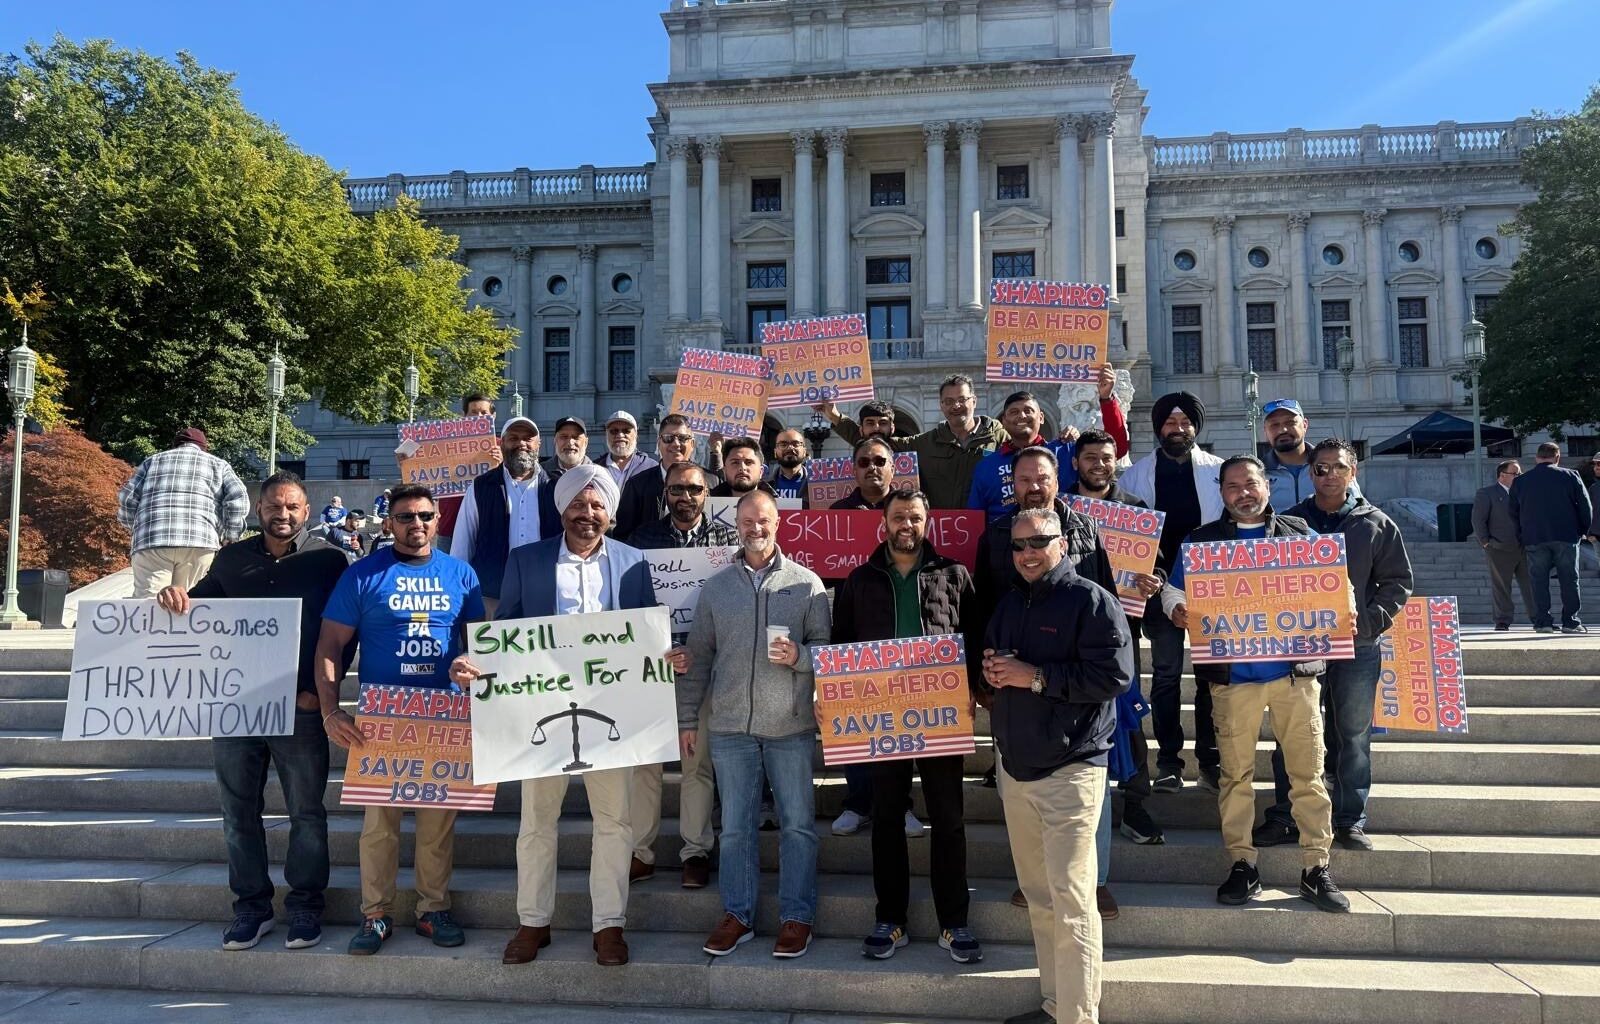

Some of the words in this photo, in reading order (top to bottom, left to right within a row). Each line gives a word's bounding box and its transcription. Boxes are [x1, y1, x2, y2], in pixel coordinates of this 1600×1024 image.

[994, 282, 1106, 307] SHAPIRO
[763, 317, 862, 343] SHAPIRO
[993, 310, 1019, 328] BE
[1024, 311, 1039, 329] A
[1045, 312, 1103, 332] HERO
[766, 347, 789, 362] BE
[795, 345, 808, 360] A
[813, 341, 863, 358] HERO
[996, 341, 1047, 359] SAVE
[1052, 343, 1097, 361] OUR
[682, 351, 770, 378] SHAPIRO
[774, 370, 818, 387] SAVE
[823, 365, 862, 382] OUR
[1001, 361, 1091, 380] BUSINESS
[680, 373, 700, 388] BE
[703, 376, 714, 390] A
[719, 379, 765, 398] HERO
[800, 384, 840, 404] JOBS
[678, 399, 715, 417] SAVE
[721, 404, 756, 422] OUR
[401, 418, 491, 440] SHAPIRO
[429, 444, 441, 459] A
[446, 439, 492, 456] HERO
[410, 466, 450, 482] SAVE
[812, 485, 837, 500] BE
[786, 512, 856, 542] SKILL
[1062, 495, 1158, 534] APIRO
[1102, 534, 1151, 559] ERO
[1188, 537, 1340, 572] SHAPIRO
[396, 576, 443, 592] SKILL
[651, 577, 706, 590] Busines
[1191, 579, 1226, 600] BE
[1234, 577, 1254, 597] A
[1261, 572, 1342, 596] HERO
[388, 594, 450, 611] GAMES
[1201, 612, 1268, 636] SAVE
[1276, 609, 1338, 632] OUR
[1405, 602, 1425, 631] BE
[408, 622, 430, 637] PA
[583, 621, 635, 645] and
[395, 640, 442, 657] JOBS
[816, 639, 960, 675] SHAPIRO
[1210, 634, 1332, 657] BUSINESS
[1407, 637, 1426, 654] A
[1429, 600, 1463, 728] SHAPIRO
[75, 666, 244, 701] THRIVING
[475, 672, 574, 701] Justice
[584, 657, 630, 687] For
[642, 655, 674, 684] All
[822, 680, 855, 702] BE
[861, 678, 881, 699] A
[887, 671, 961, 696] HERO
[363, 687, 472, 719] SHAPI
[1380, 669, 1401, 718] OUR
[1409, 660, 1432, 724] HERO
[80, 696, 287, 738] DOWNTOWN
[832, 712, 895, 737] SAVE
[902, 706, 959, 730] OUR
[360, 721, 395, 742] BE
[397, 723, 420, 745] A
[426, 725, 473, 748] HE
[869, 732, 926, 759] JOBS
[358, 756, 425, 779] SAVE
[431, 760, 473, 782] OU
[390, 781, 449, 802] JOBS
